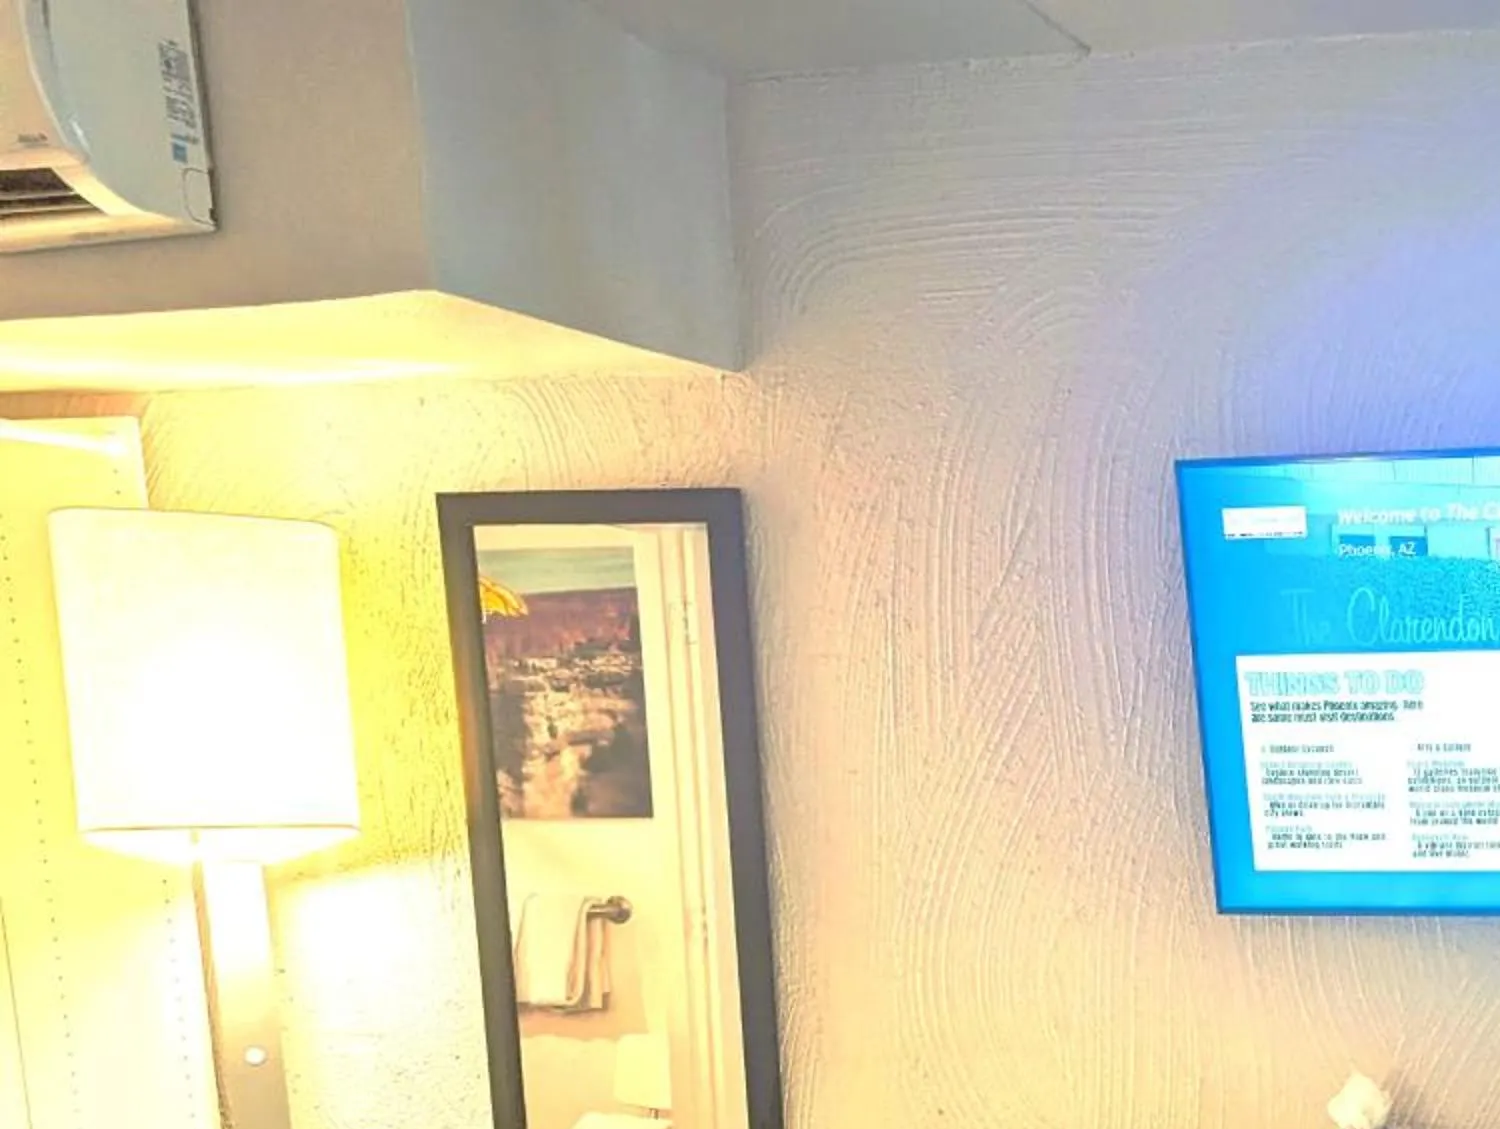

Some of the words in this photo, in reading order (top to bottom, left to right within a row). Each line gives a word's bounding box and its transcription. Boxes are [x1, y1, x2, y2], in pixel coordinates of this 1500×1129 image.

[1338, 509, 1415, 526] Welcome
[1421, 507, 1441, 522] to
[1400, 542, 1417, 555] AZ
[1280, 587, 1330, 647] The
[1347, 586, 1499, 646] Clarendon
[1245, 671, 1339, 696] THINGS
[1344, 670, 1380, 695] TO
[1385, 669, 1424, 694] DO
